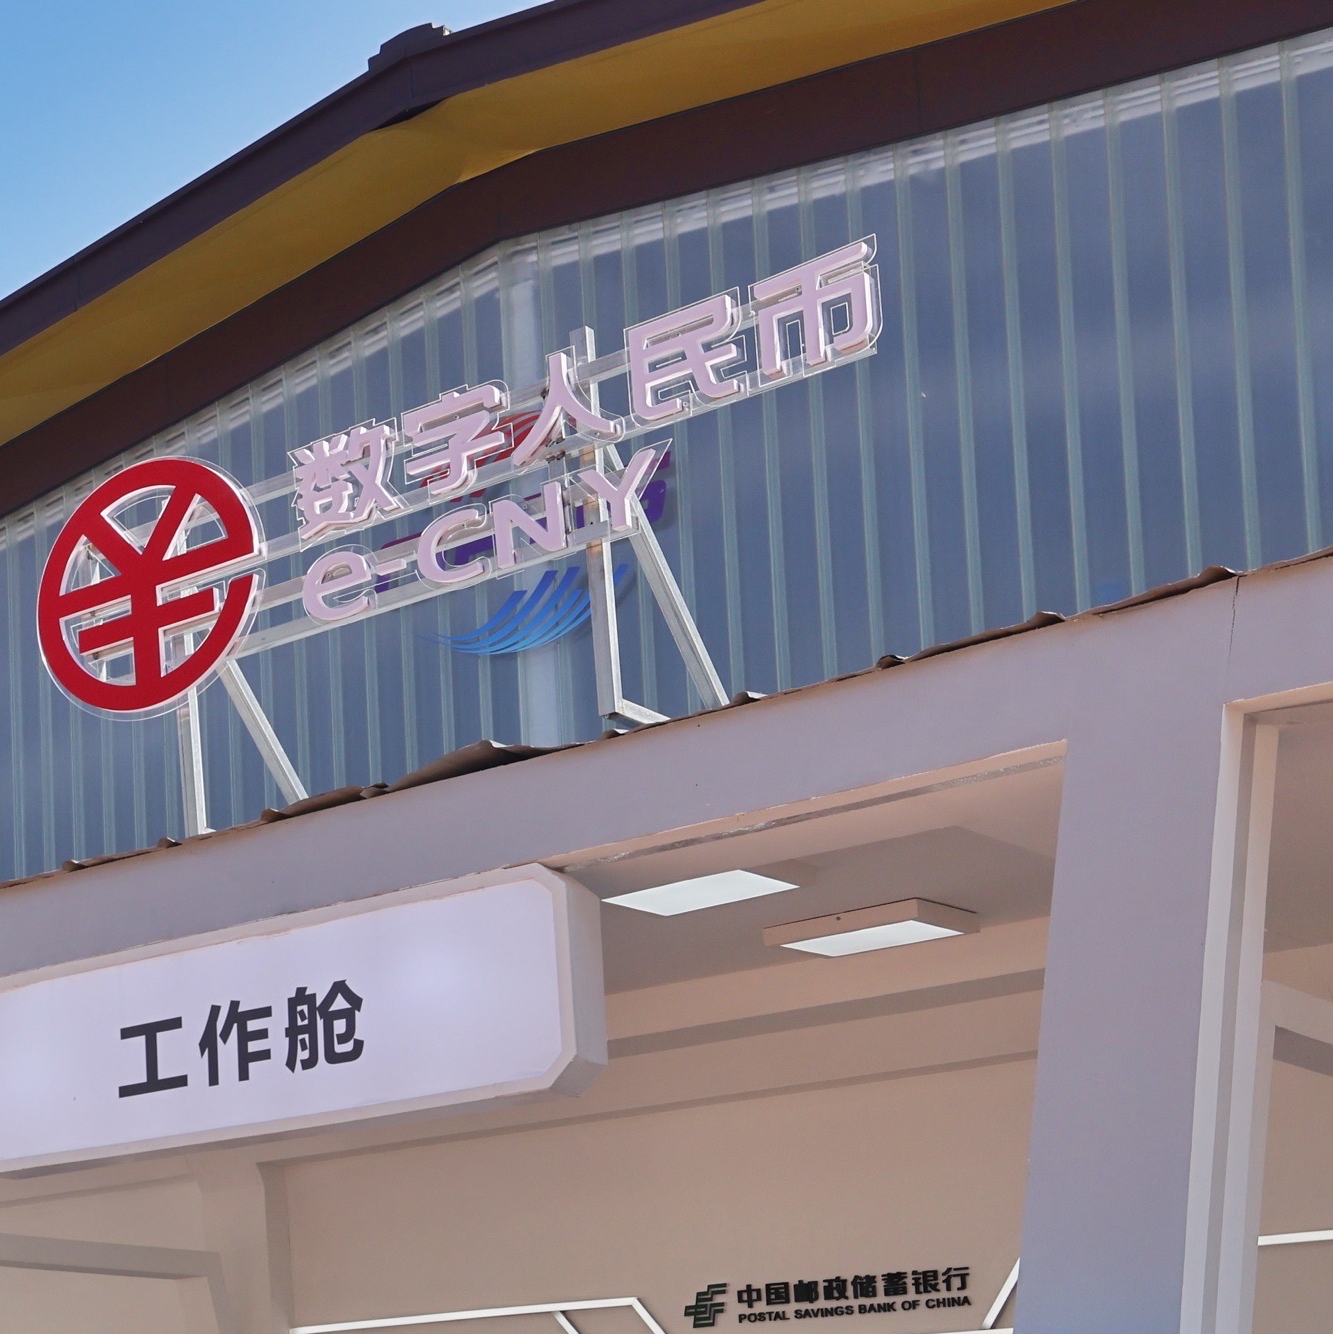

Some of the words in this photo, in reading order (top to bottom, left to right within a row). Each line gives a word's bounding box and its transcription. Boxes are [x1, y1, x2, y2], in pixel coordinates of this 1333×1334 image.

[294, 238, 876, 542] 数字人民币
[304, 445, 664, 623] e-CNY
[118, 979, 364, 1098] 工作舱
[737, 1267, 970, 1308] 中国邮政储蓄银行
[738, 1310, 790, 1323] POSTAL
[794, 1305, 854, 1319] SAVINGS
[858, 1302, 897, 1314] BANK
[901, 1300, 921, 1311] OF
[927, 1295, 971, 1309] CHINA
